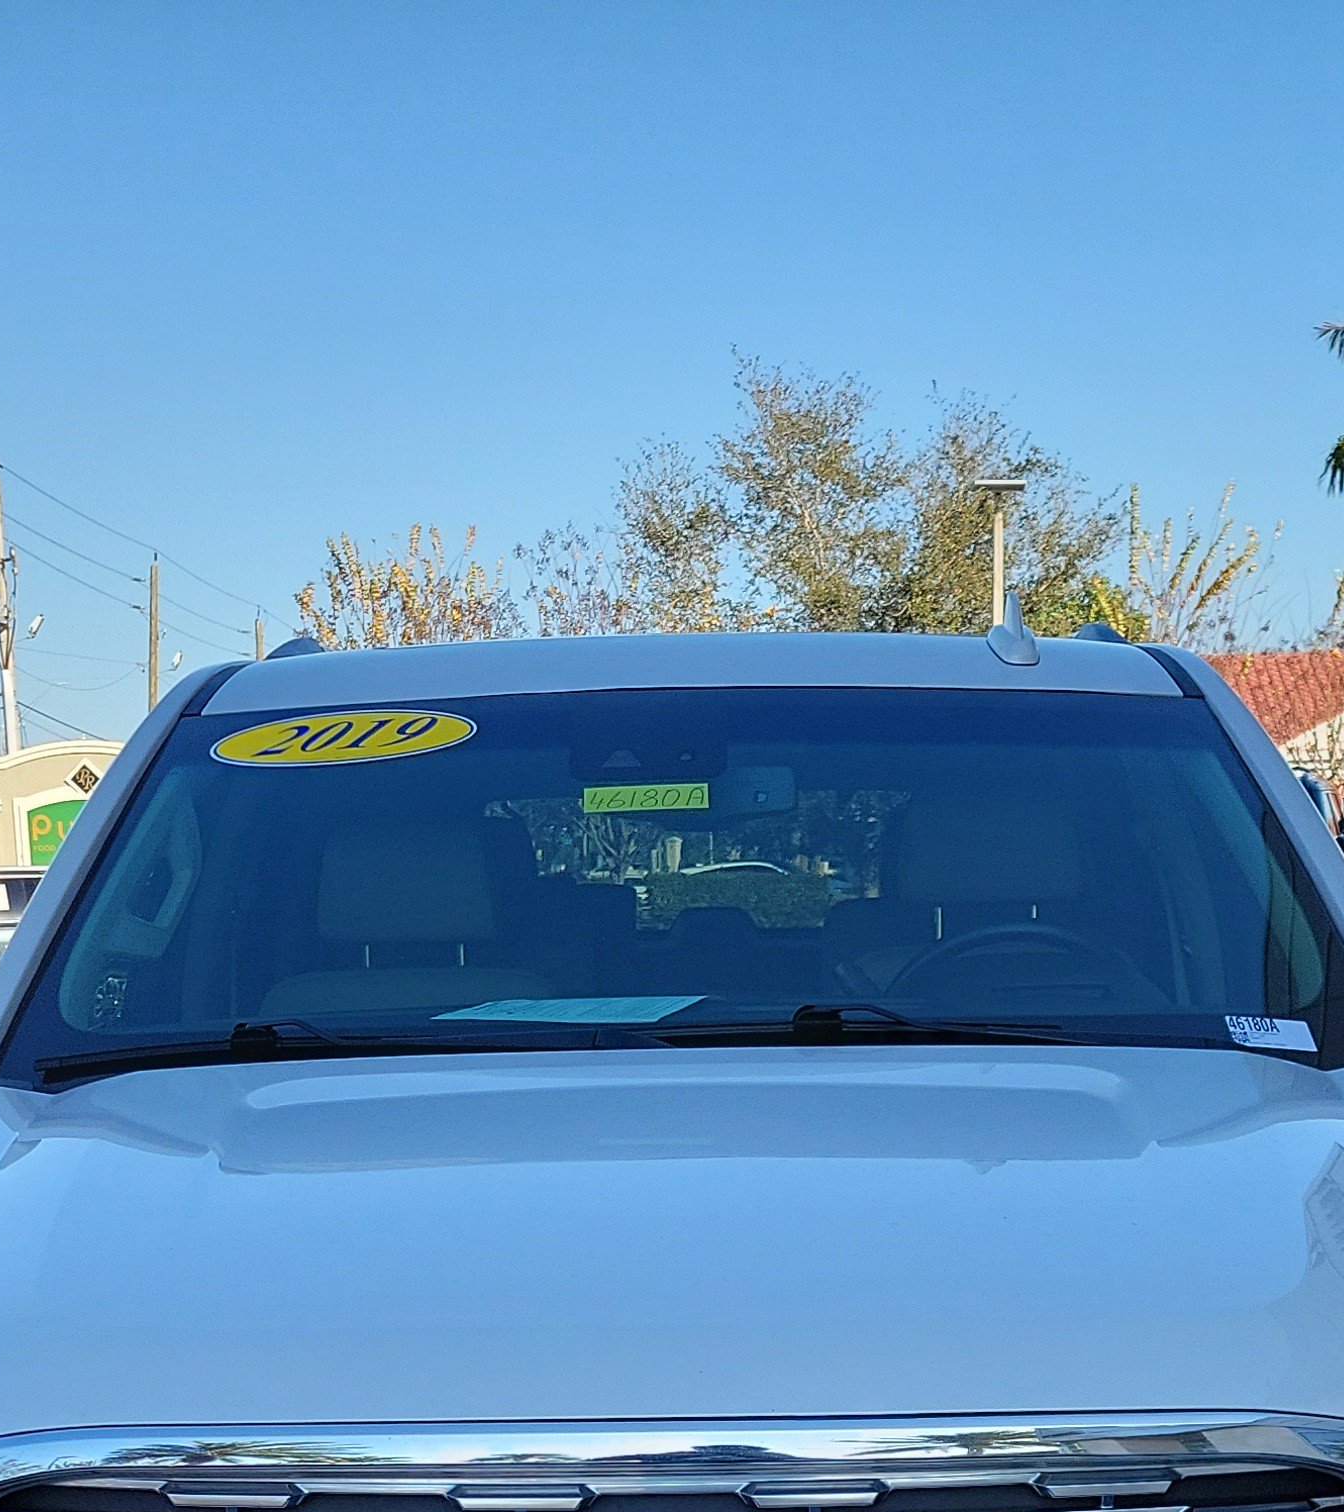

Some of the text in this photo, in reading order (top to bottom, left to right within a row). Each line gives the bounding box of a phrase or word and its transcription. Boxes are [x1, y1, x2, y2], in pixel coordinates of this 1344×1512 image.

[251, 716, 439, 757] 2019
[590, 787, 705, 809] 46180A
[1229, 1016, 1280, 1033] 46180A
